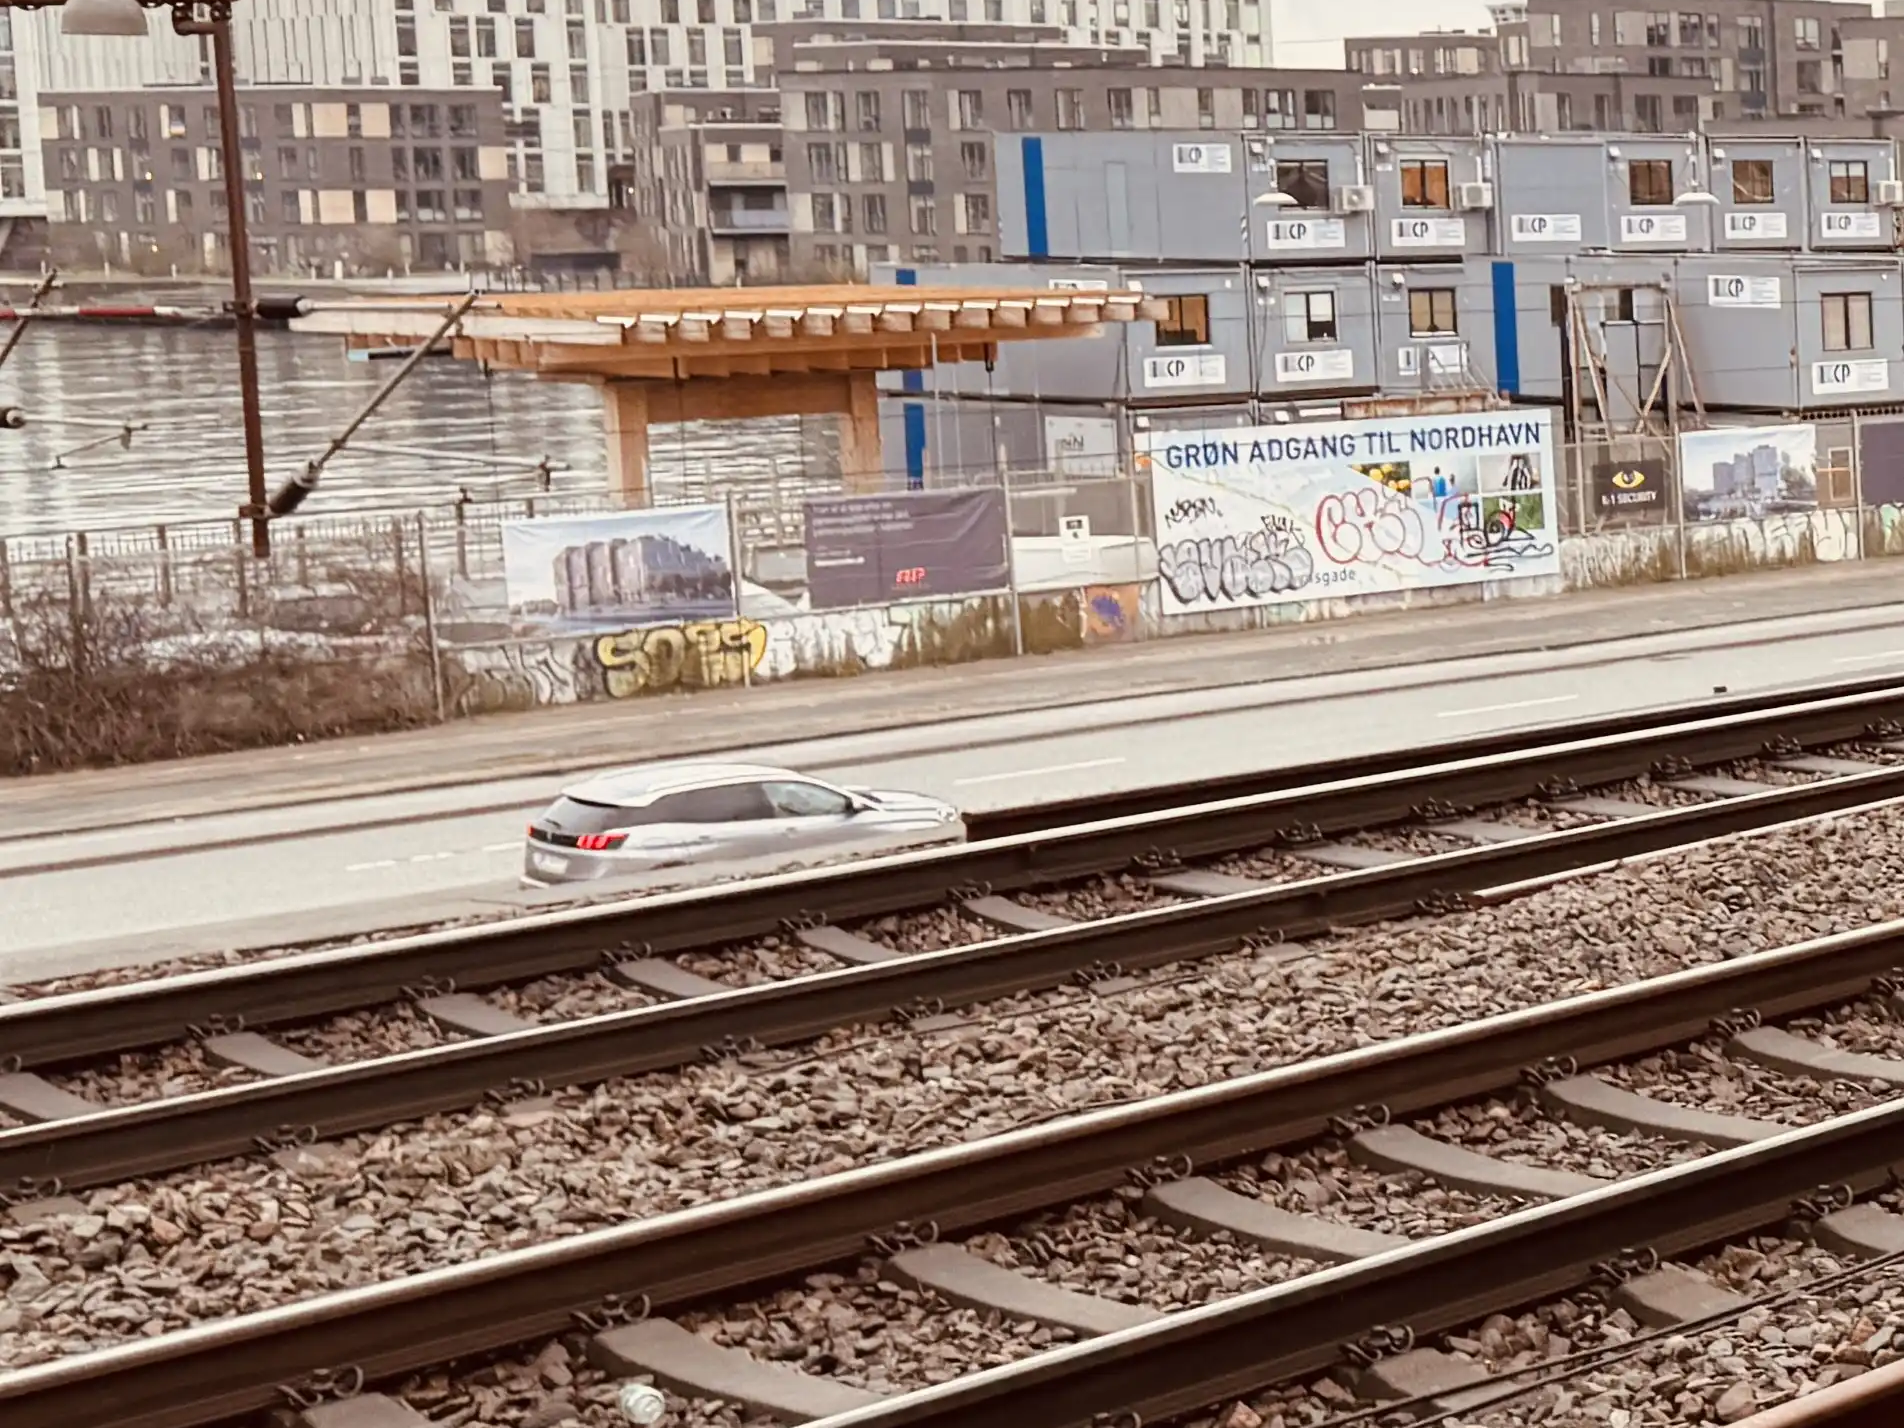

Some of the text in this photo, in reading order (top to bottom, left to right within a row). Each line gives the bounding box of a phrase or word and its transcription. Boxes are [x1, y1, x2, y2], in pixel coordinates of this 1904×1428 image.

[1166, 422, 1541, 470] GRØN ADGANG TIL NORDHAVN
